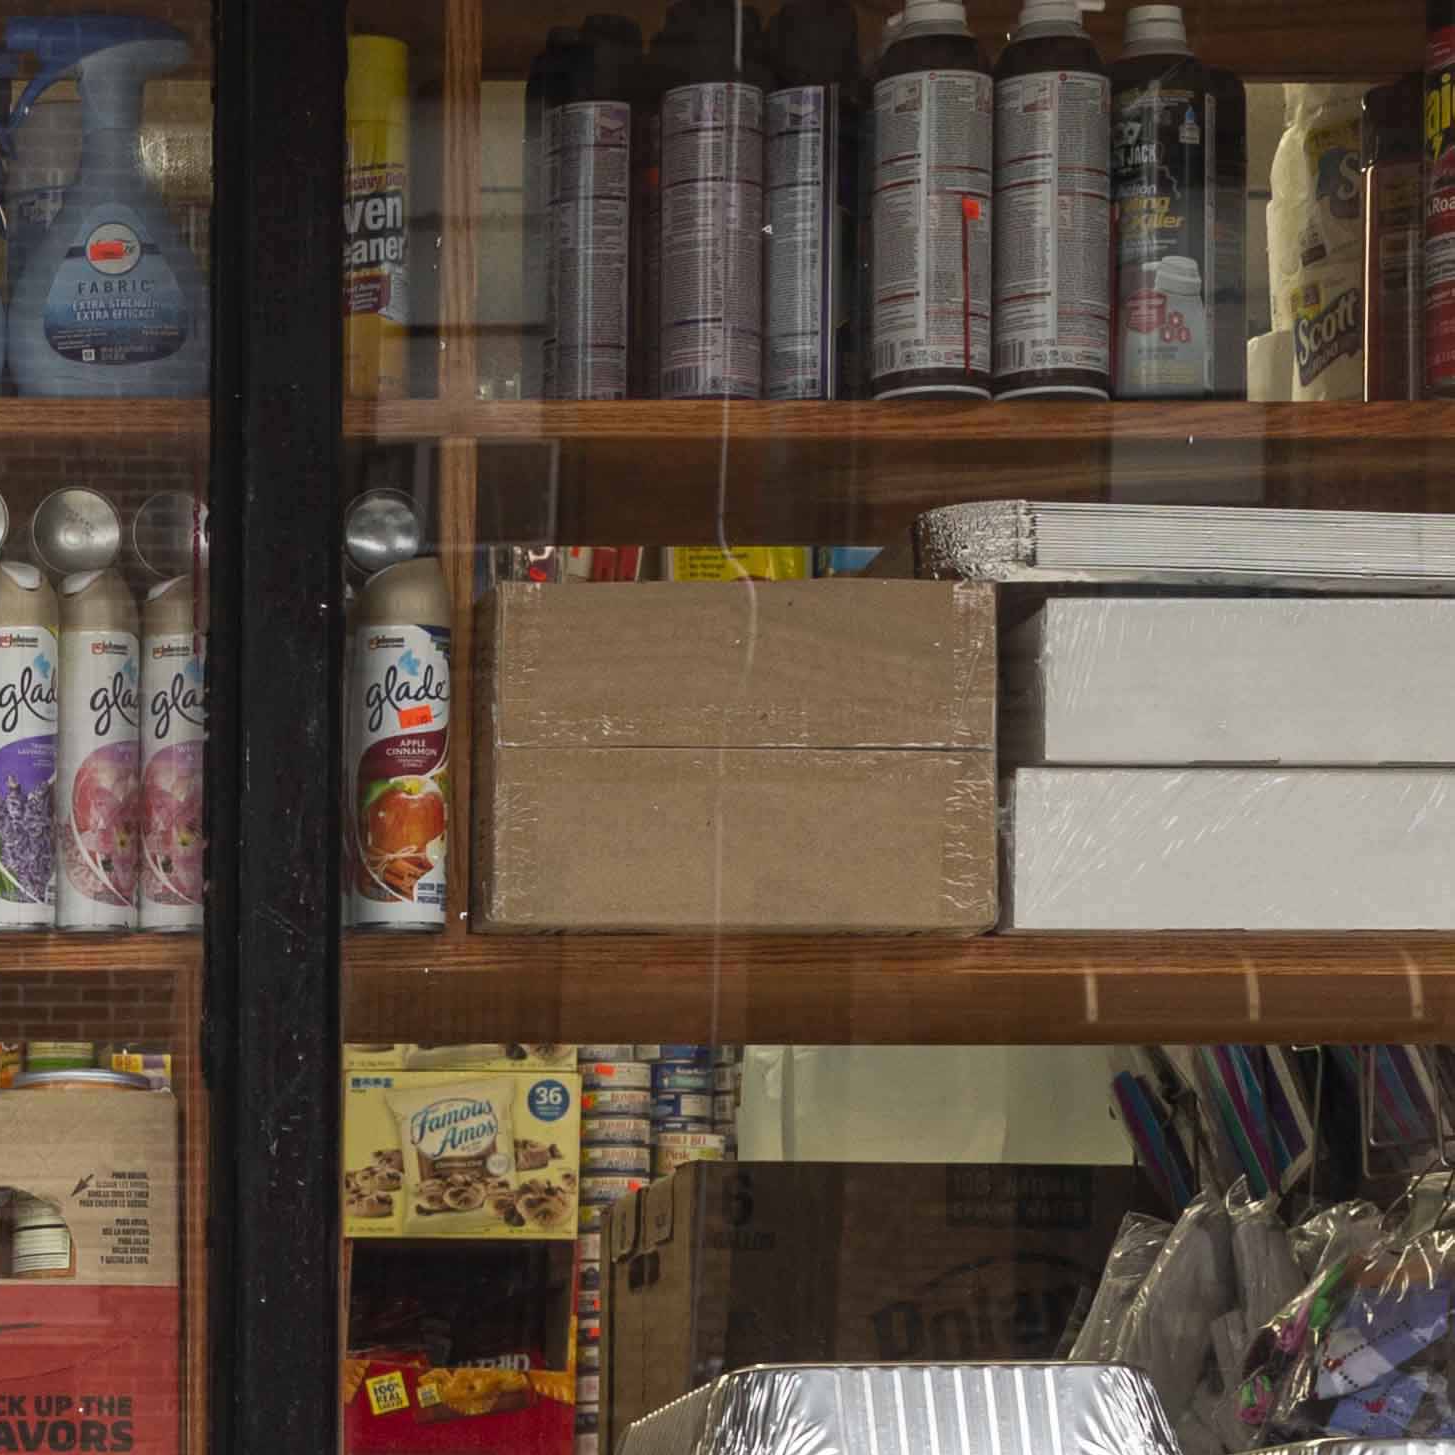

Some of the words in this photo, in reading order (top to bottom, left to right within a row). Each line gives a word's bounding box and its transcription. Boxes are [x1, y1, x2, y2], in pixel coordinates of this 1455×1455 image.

[343, 196, 403, 234] ven
[77, 280, 151, 295] FABRIC
[1297, 290, 1362, 367] Scott
[366, 663, 450, 732] glade
[385, 748, 437, 757] CINNAMON
[399, 738, 426, 747] APPLE
[534, 1085, 563, 1105] 36
[411, 1097, 492, 1145] Famous
[433, 1120, 498, 1157] Amos
[34, 1394, 73, 1416] UP
[78, 1394, 134, 1416] THE
